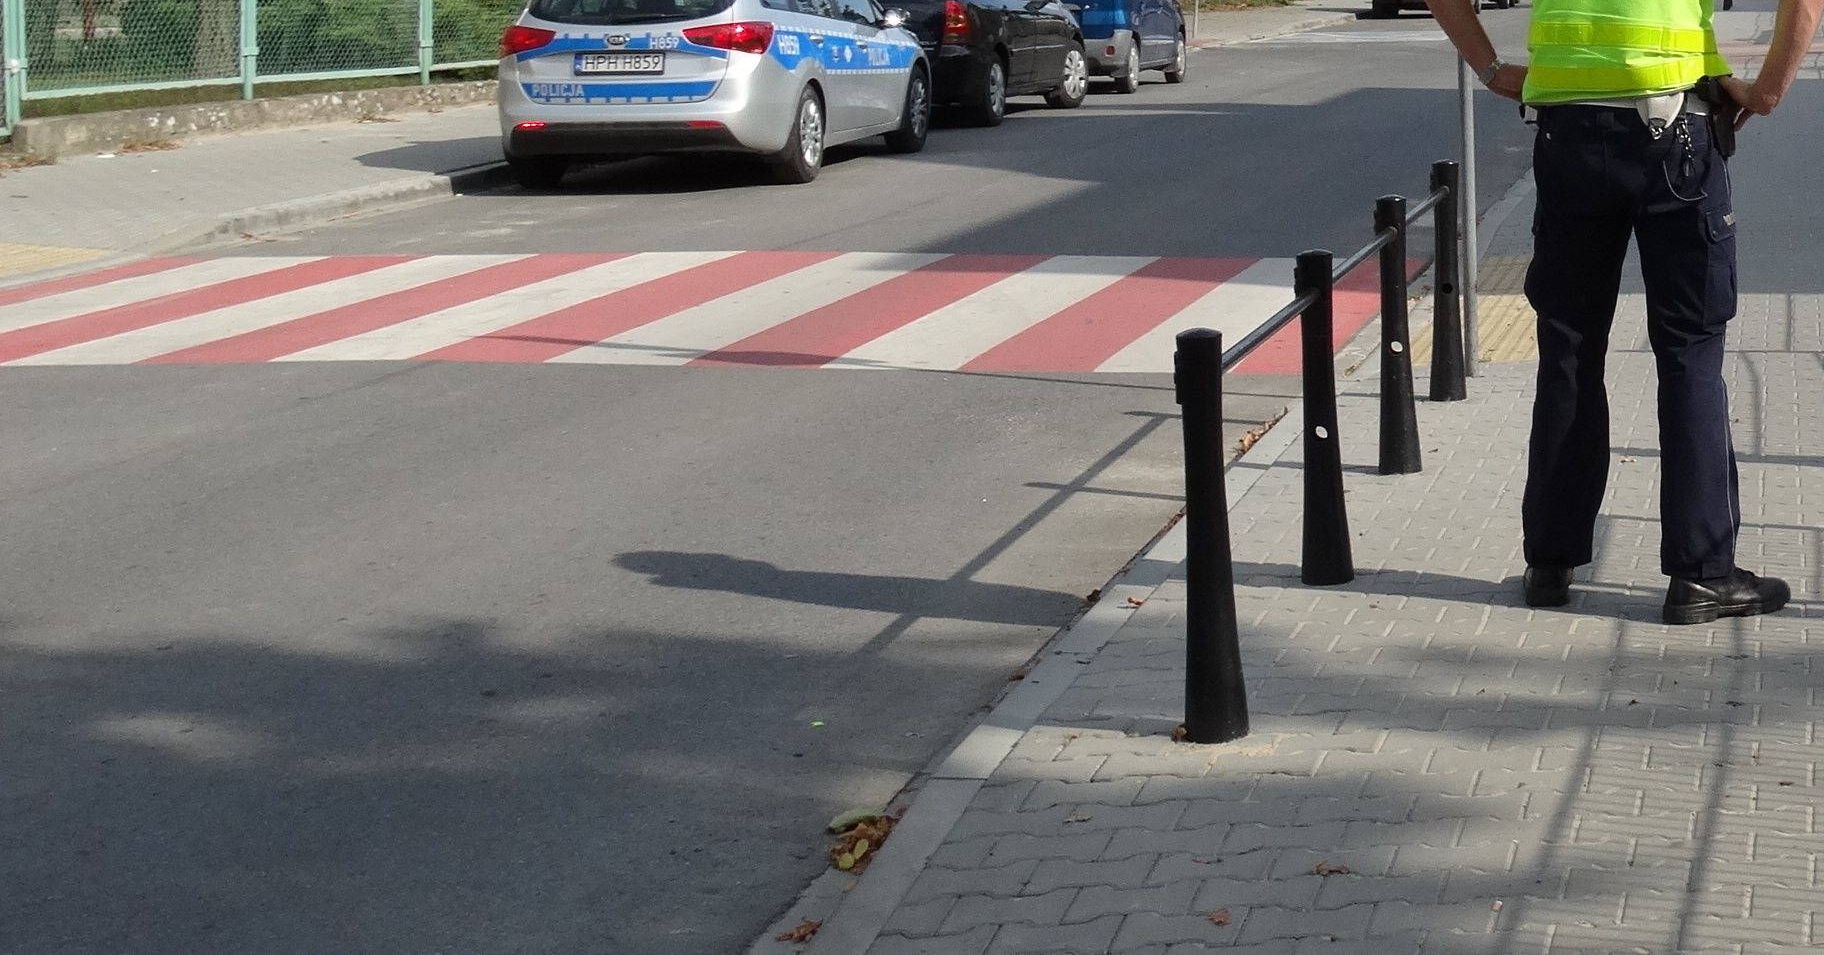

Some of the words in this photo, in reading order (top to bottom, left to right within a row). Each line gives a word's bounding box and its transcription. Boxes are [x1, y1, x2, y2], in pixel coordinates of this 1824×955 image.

[649, 36, 680, 50] H859
[584, 54, 618, 70] HPH
[623, 54, 661, 70] H859
[532, 83, 586, 97] POLICJA
